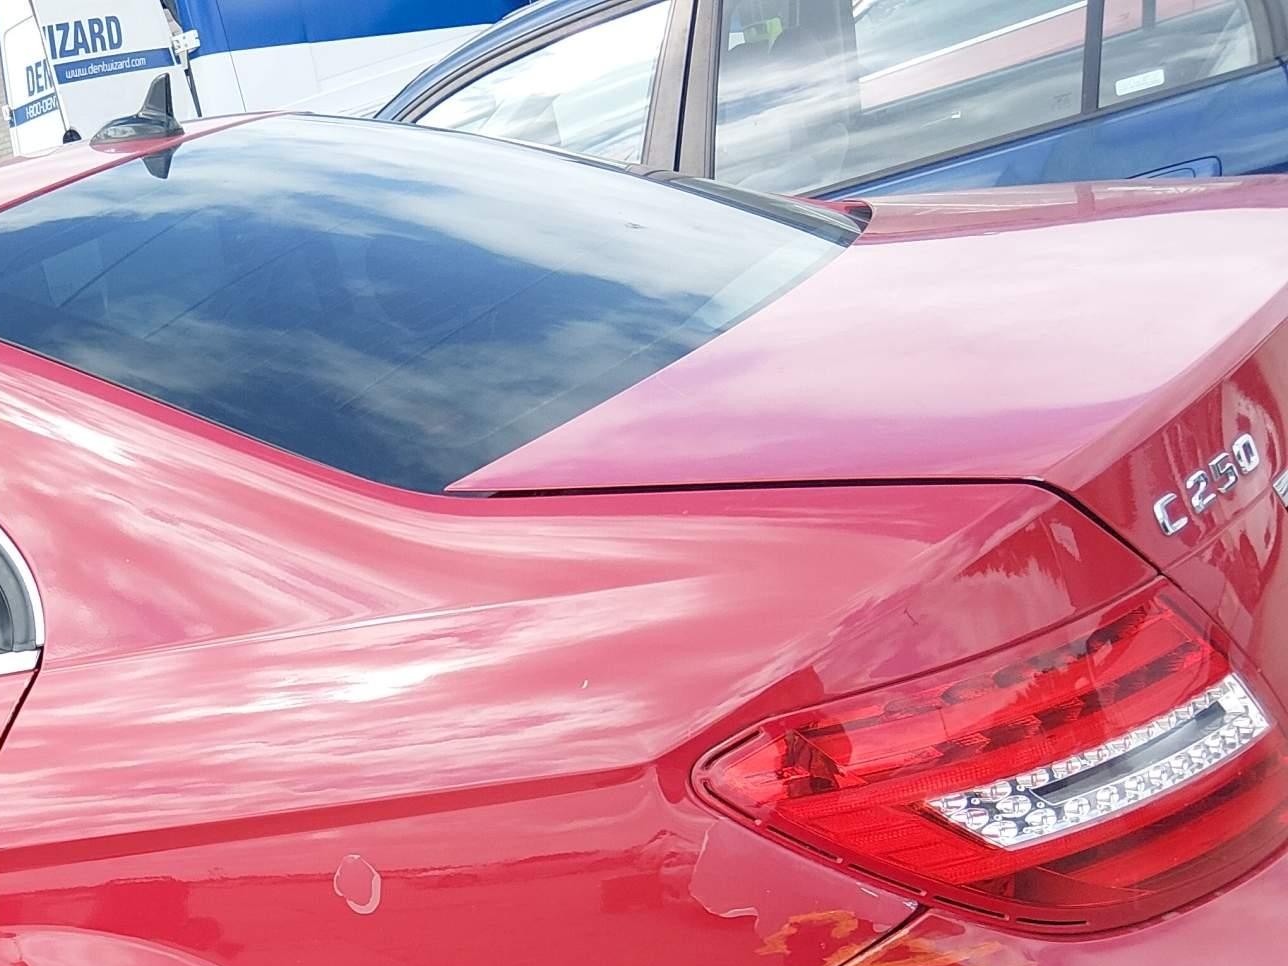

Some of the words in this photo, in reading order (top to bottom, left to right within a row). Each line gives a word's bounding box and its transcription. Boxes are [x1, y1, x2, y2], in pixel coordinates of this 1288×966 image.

[42, 16, 122, 59] IZARD
[65, 57, 146, 79] www.dentwizard.com
[1153, 492, 1189, 536] C
[1185, 433, 1260, 514] 250
